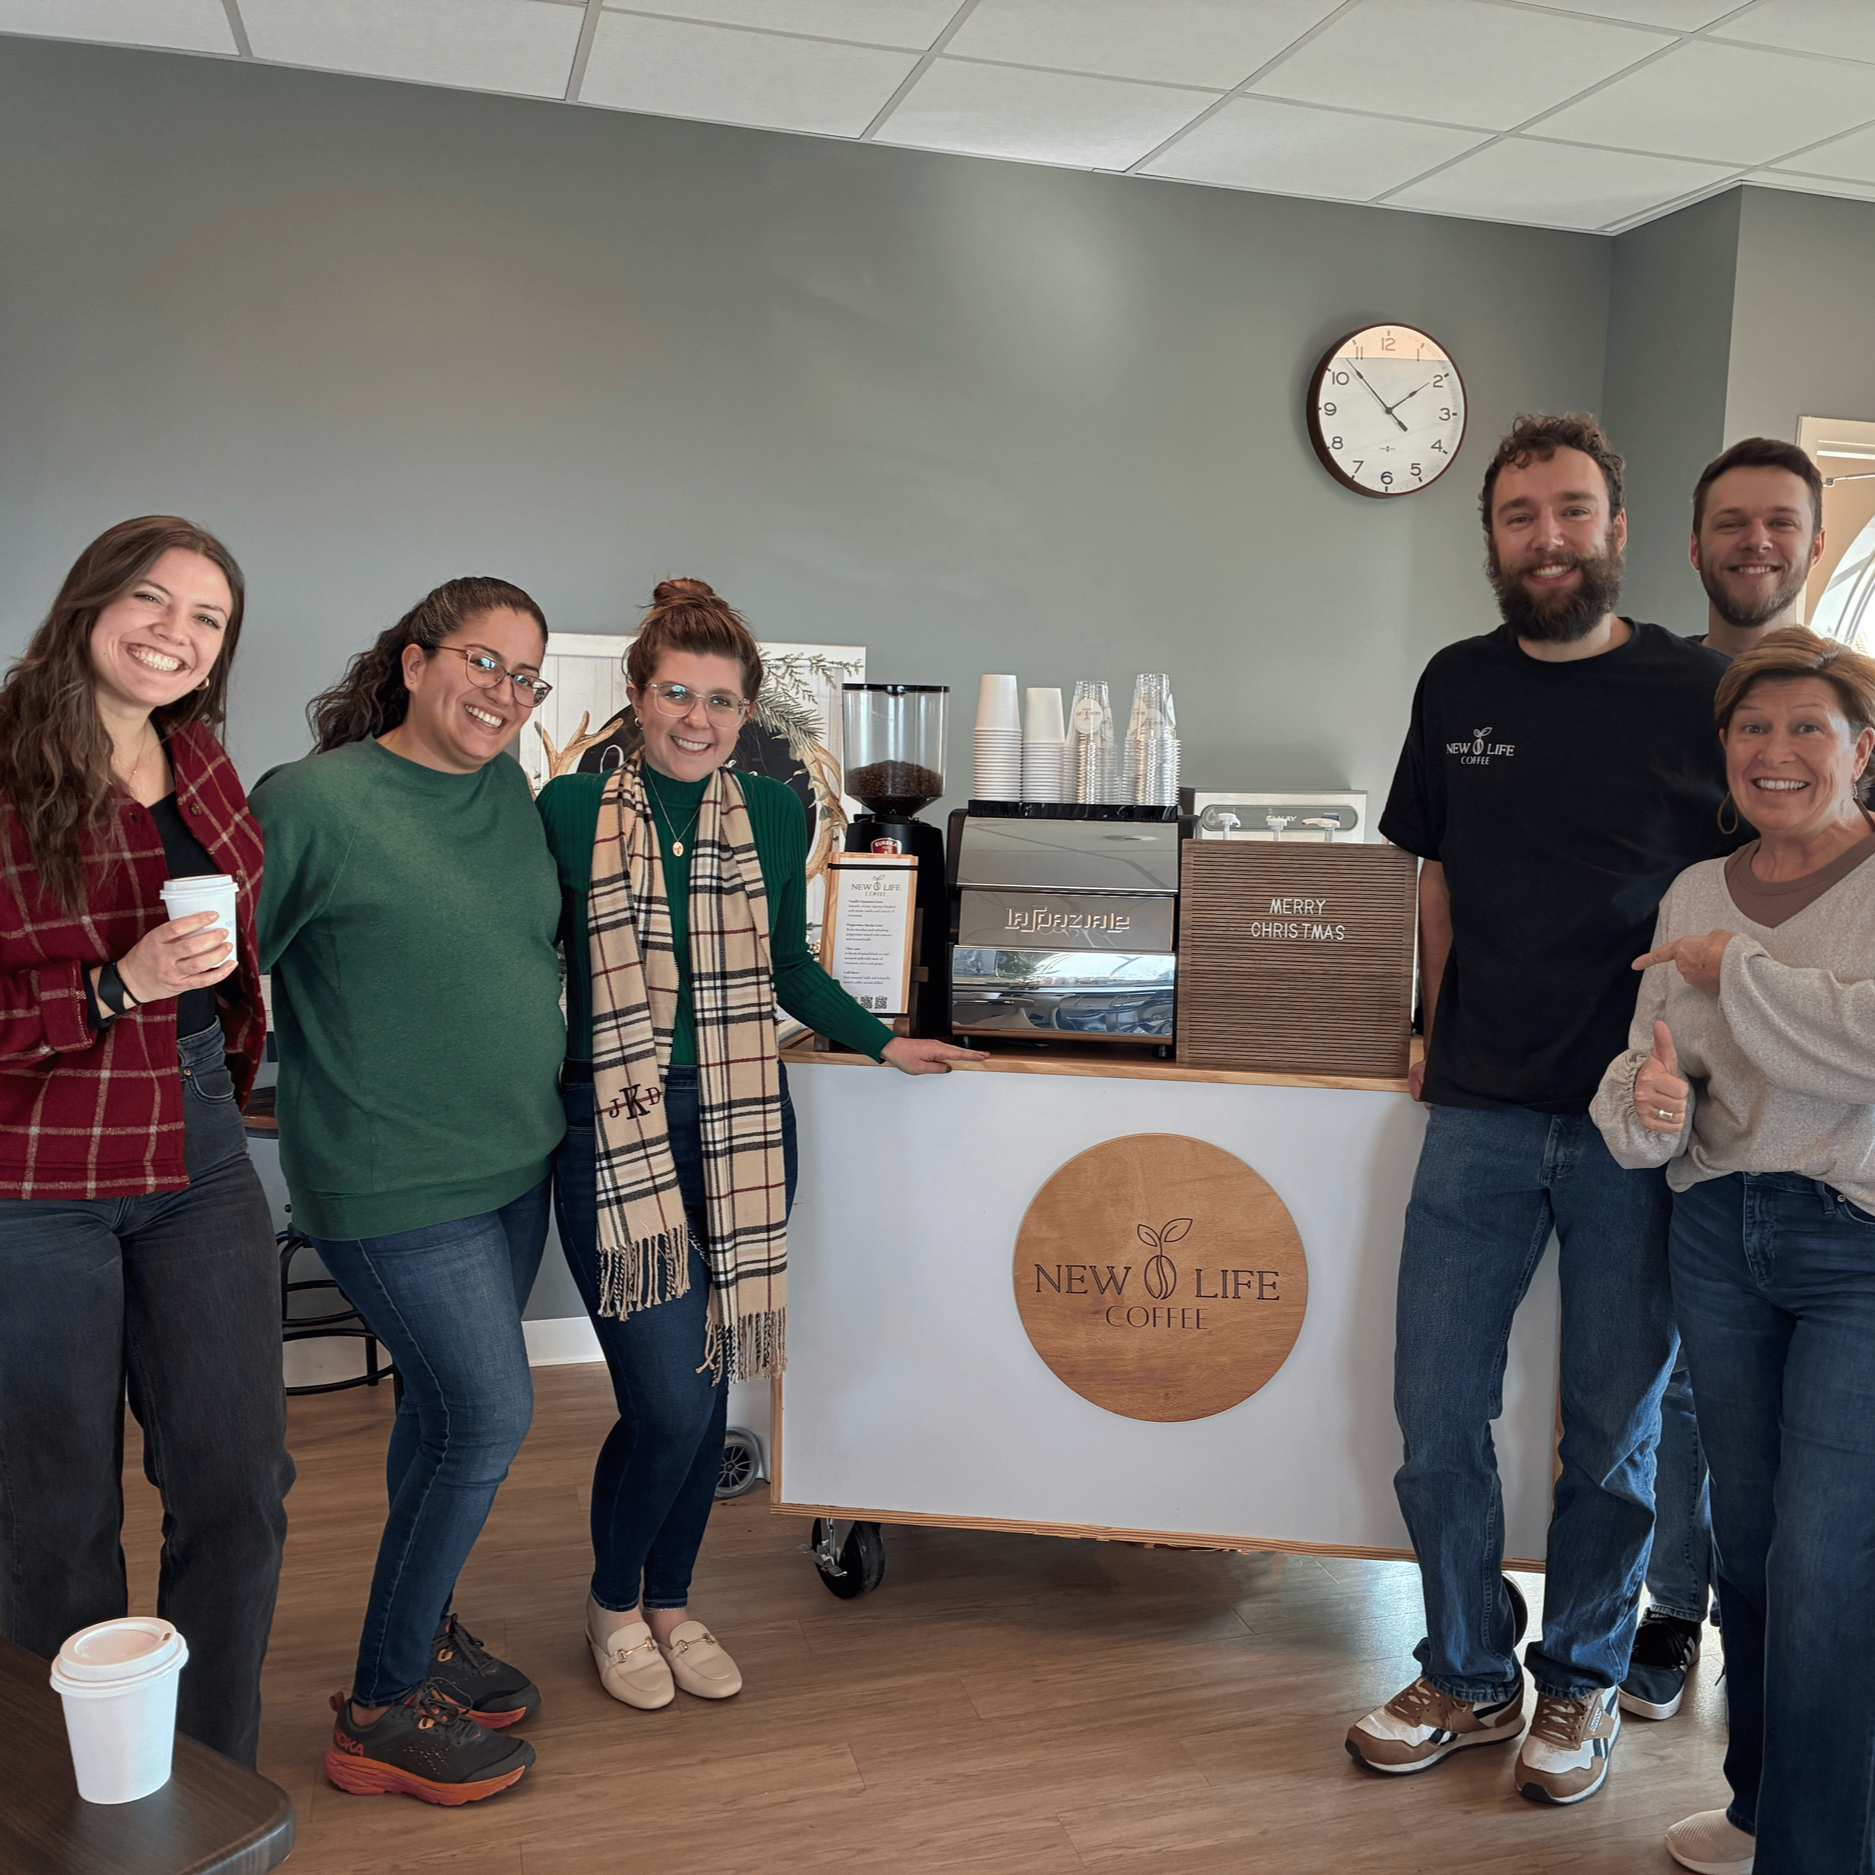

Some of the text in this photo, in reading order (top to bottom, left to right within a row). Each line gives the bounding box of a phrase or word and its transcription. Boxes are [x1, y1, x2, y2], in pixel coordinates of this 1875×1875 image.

[1381, 337, 1396, 351] 12
[1355, 346, 1364, 360] 11
[1332, 371, 1350, 386] 10
[1433, 374, 1444, 388] 2
[1323, 402, 1337, 416] 9
[1438, 407, 1451, 421] 3
[1331, 436, 1344, 450] 8
[1430, 439, 1443, 453] 4
[1352, 460, 1364, 474] 7
[1410, 463, 1422, 477] 5
[1380, 471, 1394, 485] 6
[1446, 742, 1515, 756] NEW LIFE
[1460, 756, 1490, 765] COFFEE
[851, 883, 872, 891] NEW
[1269, 898, 1327, 915] MERRY
[1250, 922, 1346, 941] CHRISTMAS
[1034, 1263, 1280, 1301] NEW LIFE
[1105, 1305, 1209, 1330] COFFEE
